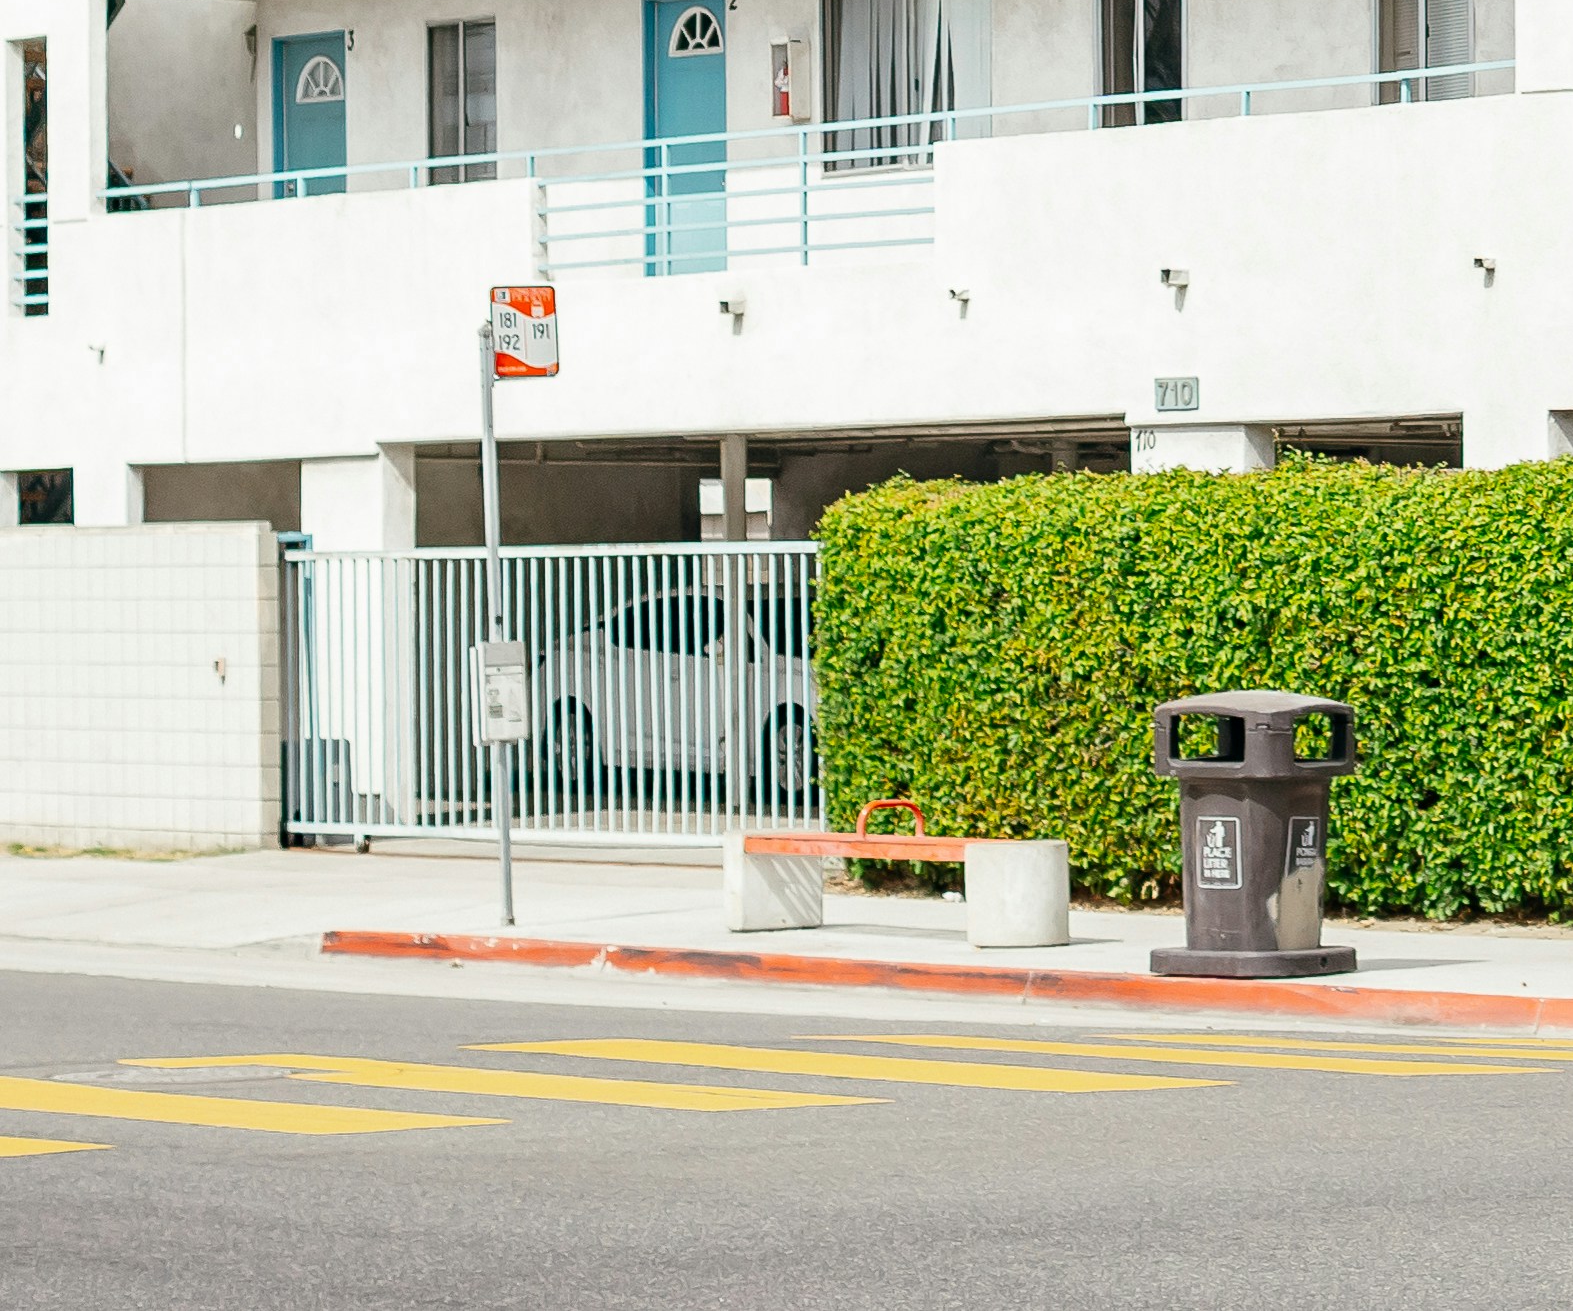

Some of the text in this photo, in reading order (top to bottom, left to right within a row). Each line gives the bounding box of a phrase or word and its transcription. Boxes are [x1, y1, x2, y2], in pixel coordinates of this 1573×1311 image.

[499, 312, 517, 328] 181
[532, 323, 550, 339] 191
[499, 334, 520, 351] 192
[1157, 381, 1193, 407] 710
